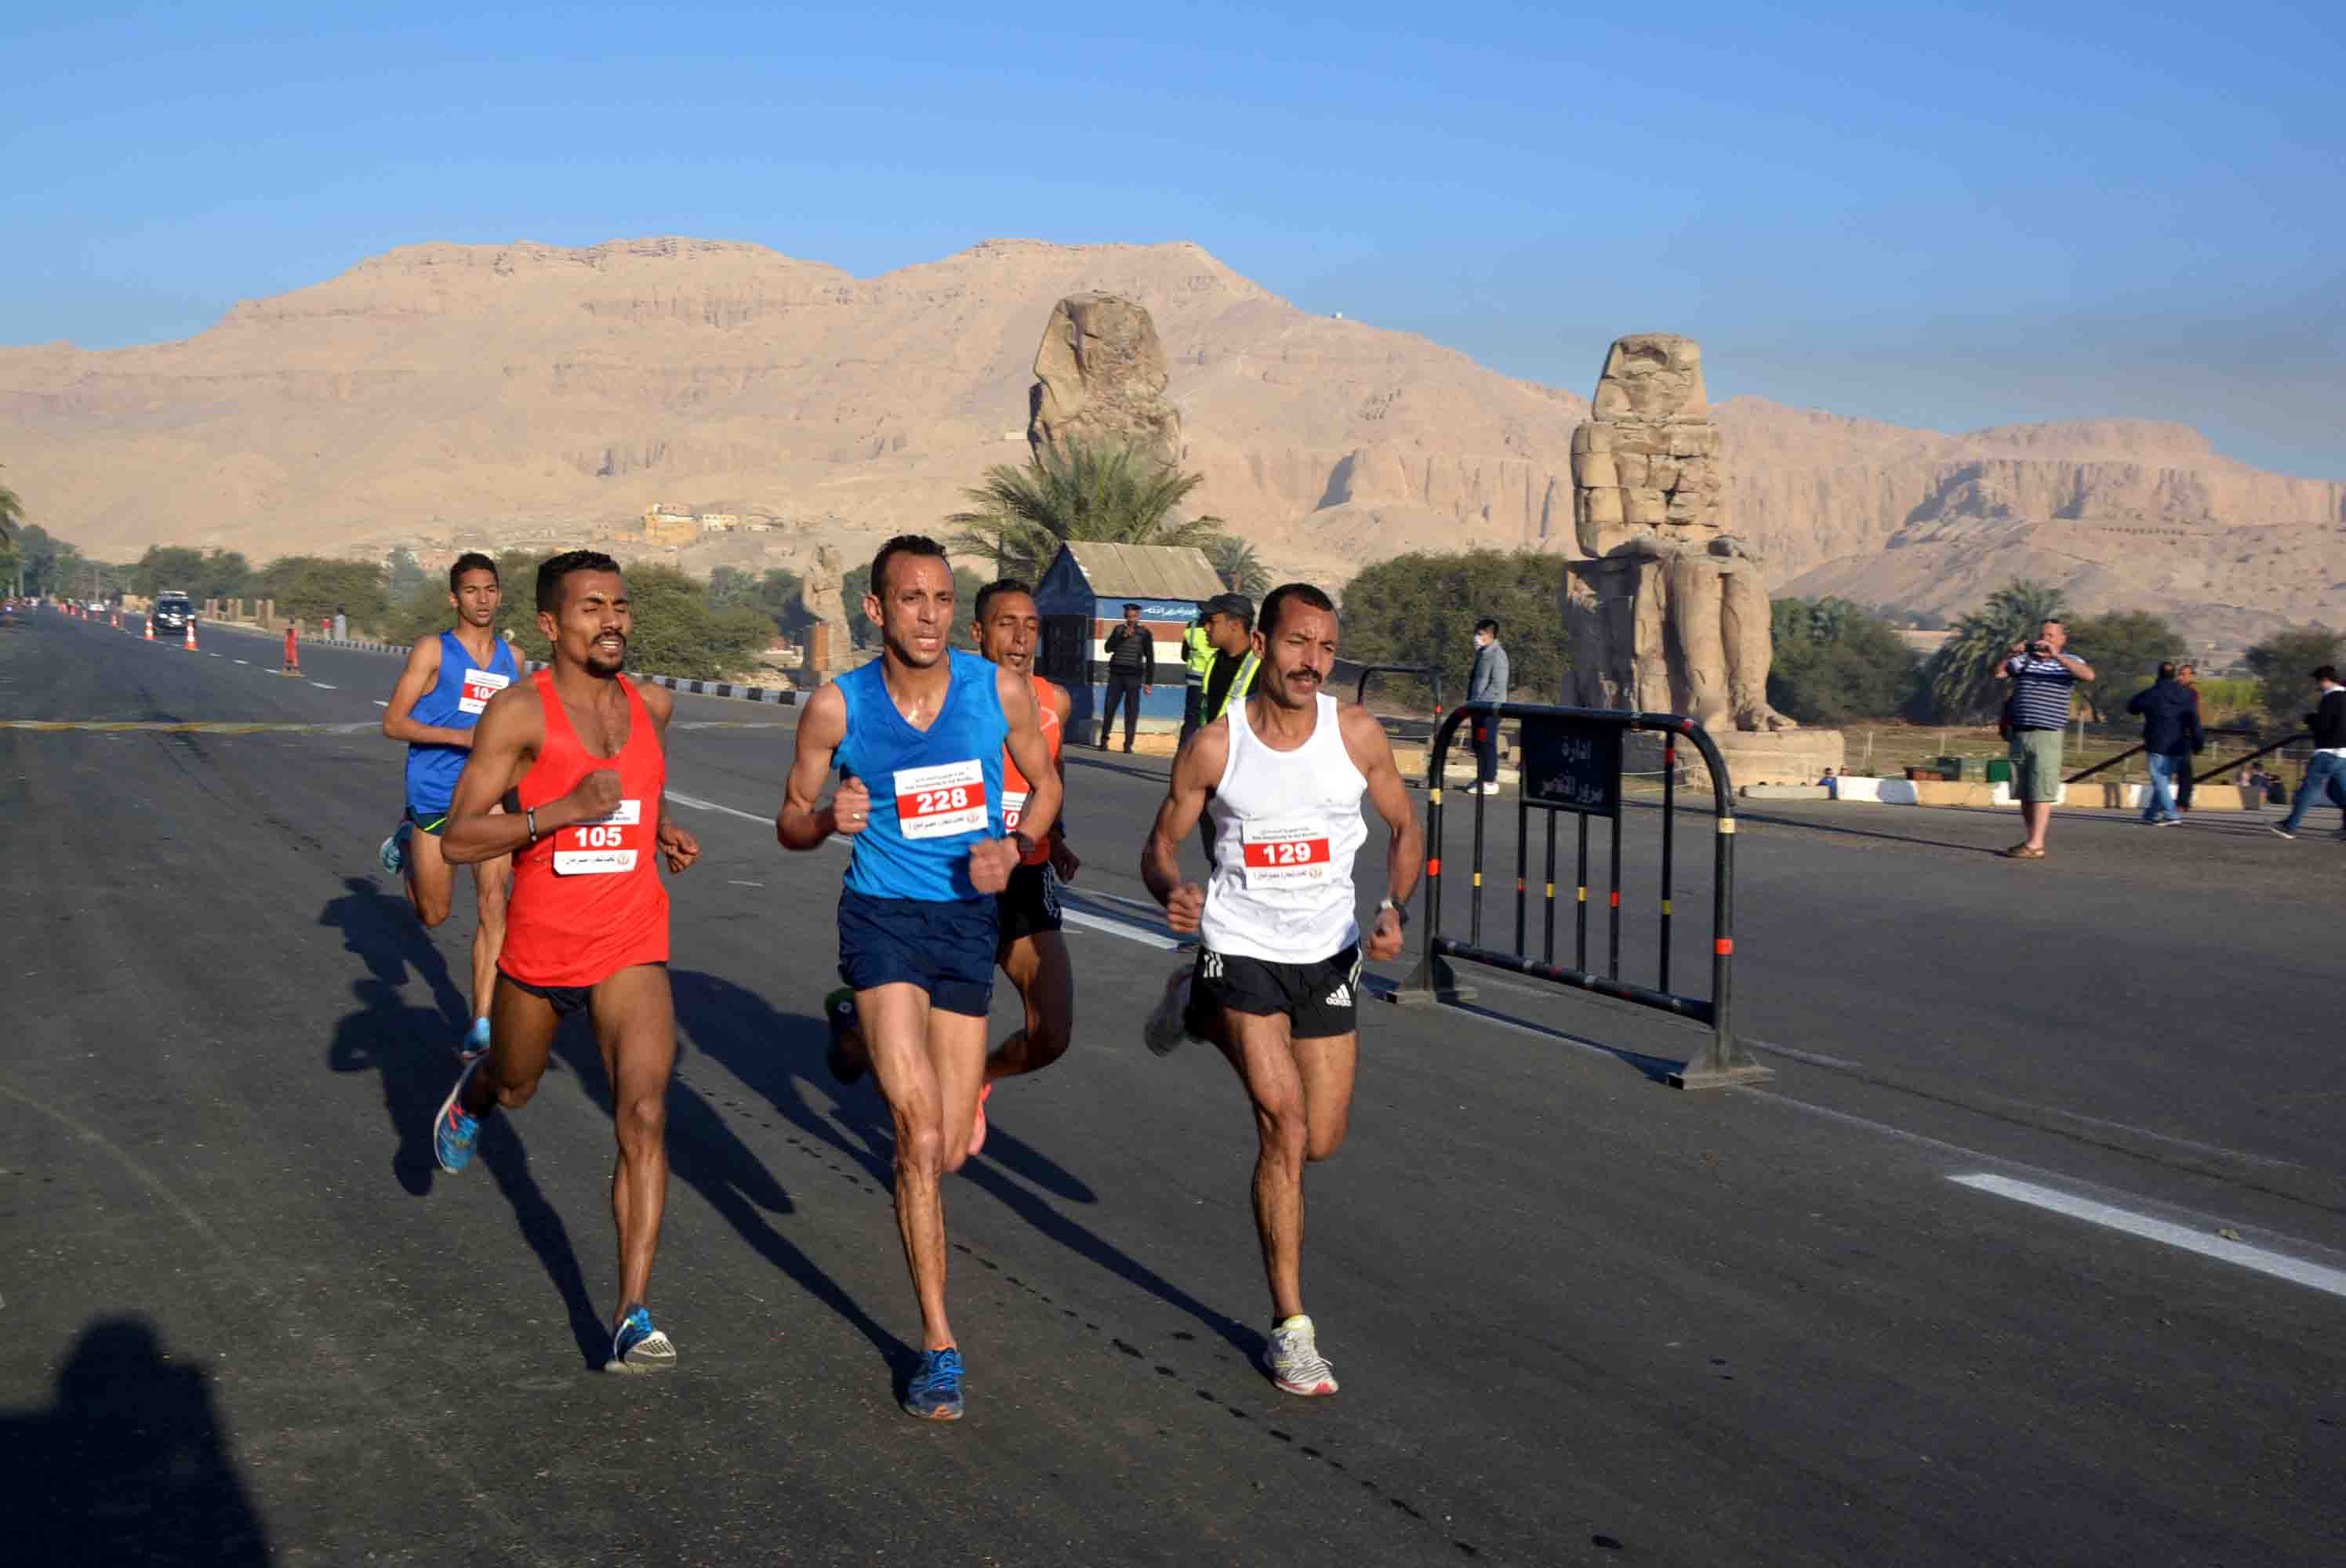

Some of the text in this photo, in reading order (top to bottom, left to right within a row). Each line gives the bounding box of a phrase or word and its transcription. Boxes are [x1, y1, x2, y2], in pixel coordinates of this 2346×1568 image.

[916, 788, 968, 815] 228
[574, 826, 622, 848] 105
[1262, 842, 1312, 866] 129
